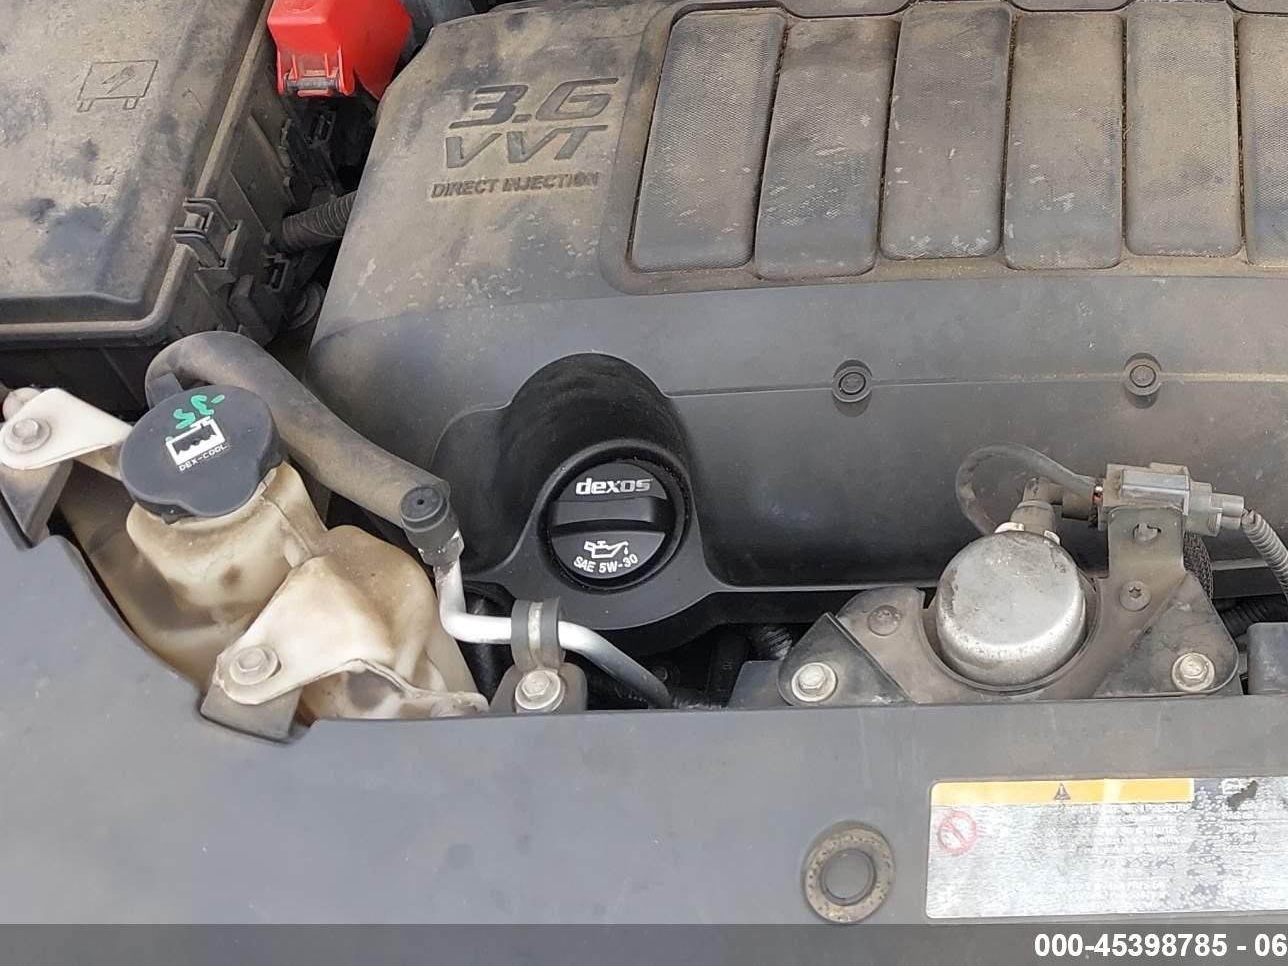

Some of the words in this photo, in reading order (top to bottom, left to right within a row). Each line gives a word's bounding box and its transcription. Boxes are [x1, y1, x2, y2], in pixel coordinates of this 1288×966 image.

[449, 77, 619, 129] 3.6
[445, 124, 608, 169] VVT
[430, 178, 499, 199] DIRECT
[501, 170, 600, 193] INJECTION
[178, 443, 228, 472] DEX-COOL
[575, 477, 653, 495] dexos
[574, 556, 595, 573] SAE
[598, 553, 638, 573] 5W-30
